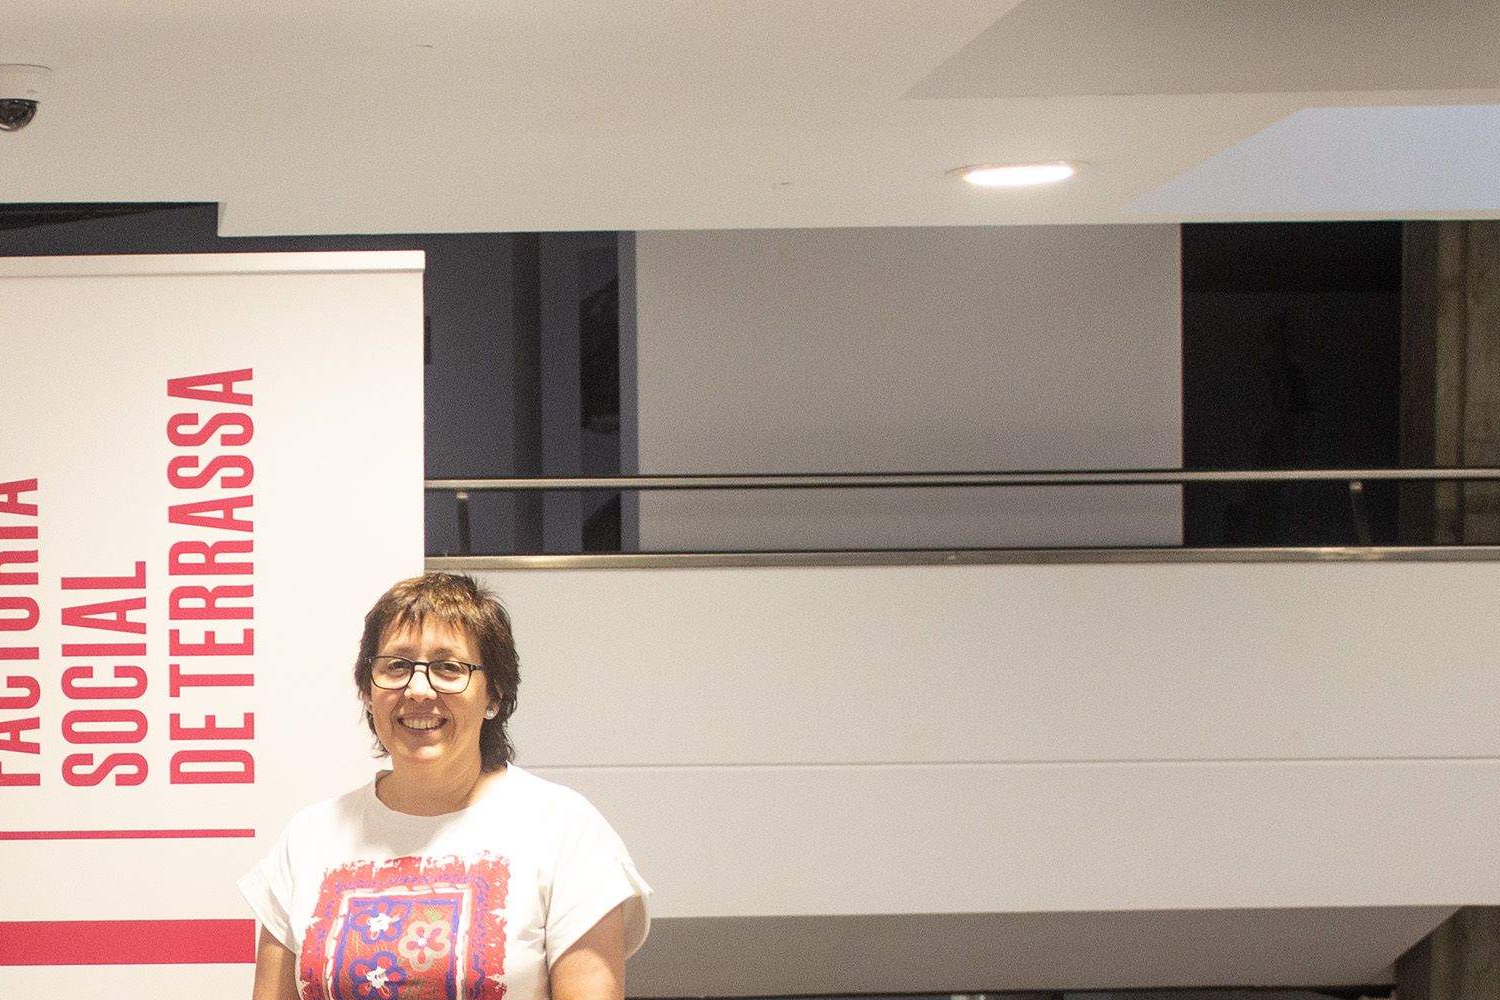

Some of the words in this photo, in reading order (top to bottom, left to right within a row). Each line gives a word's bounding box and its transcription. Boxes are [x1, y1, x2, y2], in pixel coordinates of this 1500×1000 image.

[166, 367, 255, 698] TERRASSA
[60, 560, 149, 787] SOCIAL
[168, 712, 256, 785] DE
